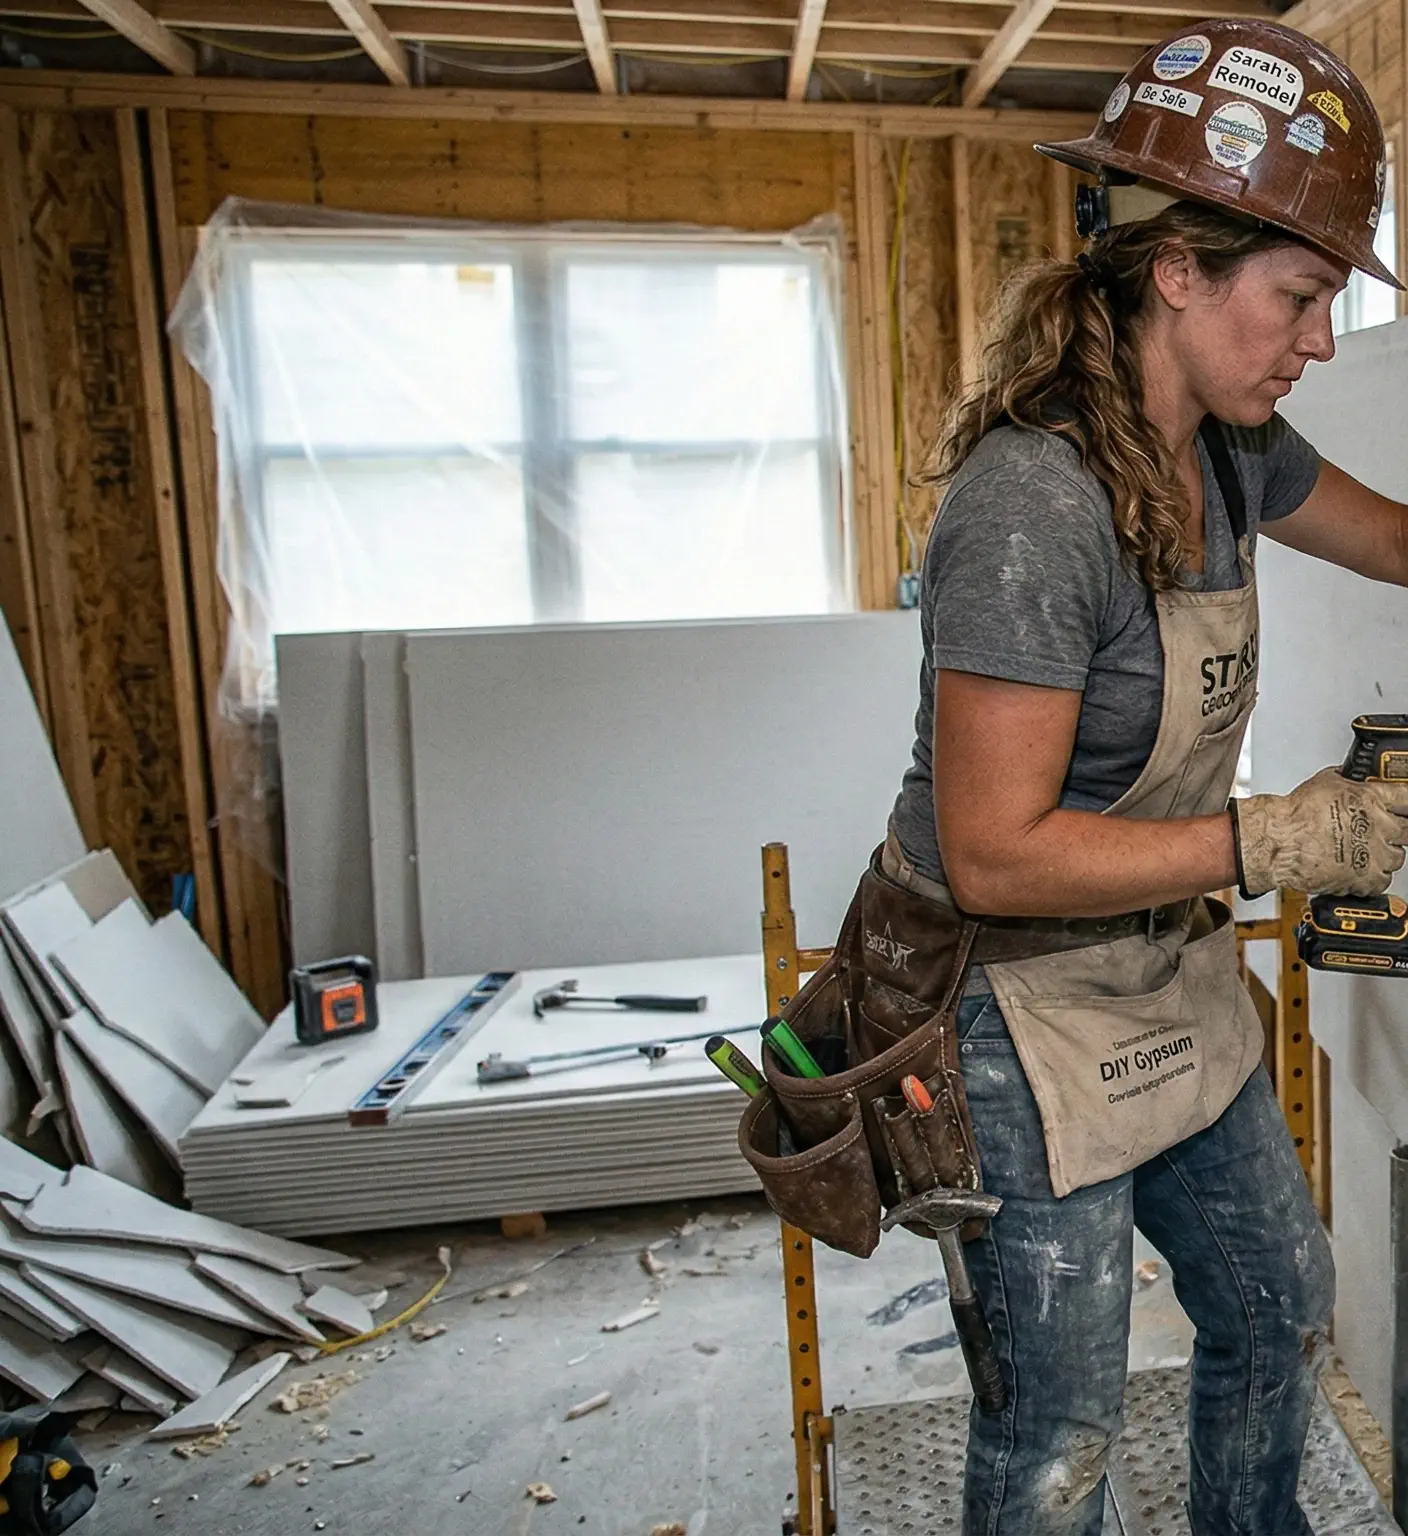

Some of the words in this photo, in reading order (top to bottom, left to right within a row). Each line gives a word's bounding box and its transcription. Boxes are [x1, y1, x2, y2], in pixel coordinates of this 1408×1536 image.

[1230, 50, 1297, 84] Sarah's
[1142, 85, 1157, 101] Be
[1160, 89, 1187, 109] Safe
[1215, 66, 1297, 107] Remodel
[1100, 1055, 1129, 1082] DIY
[1134, 1036, 1193, 1071] Gypsum
